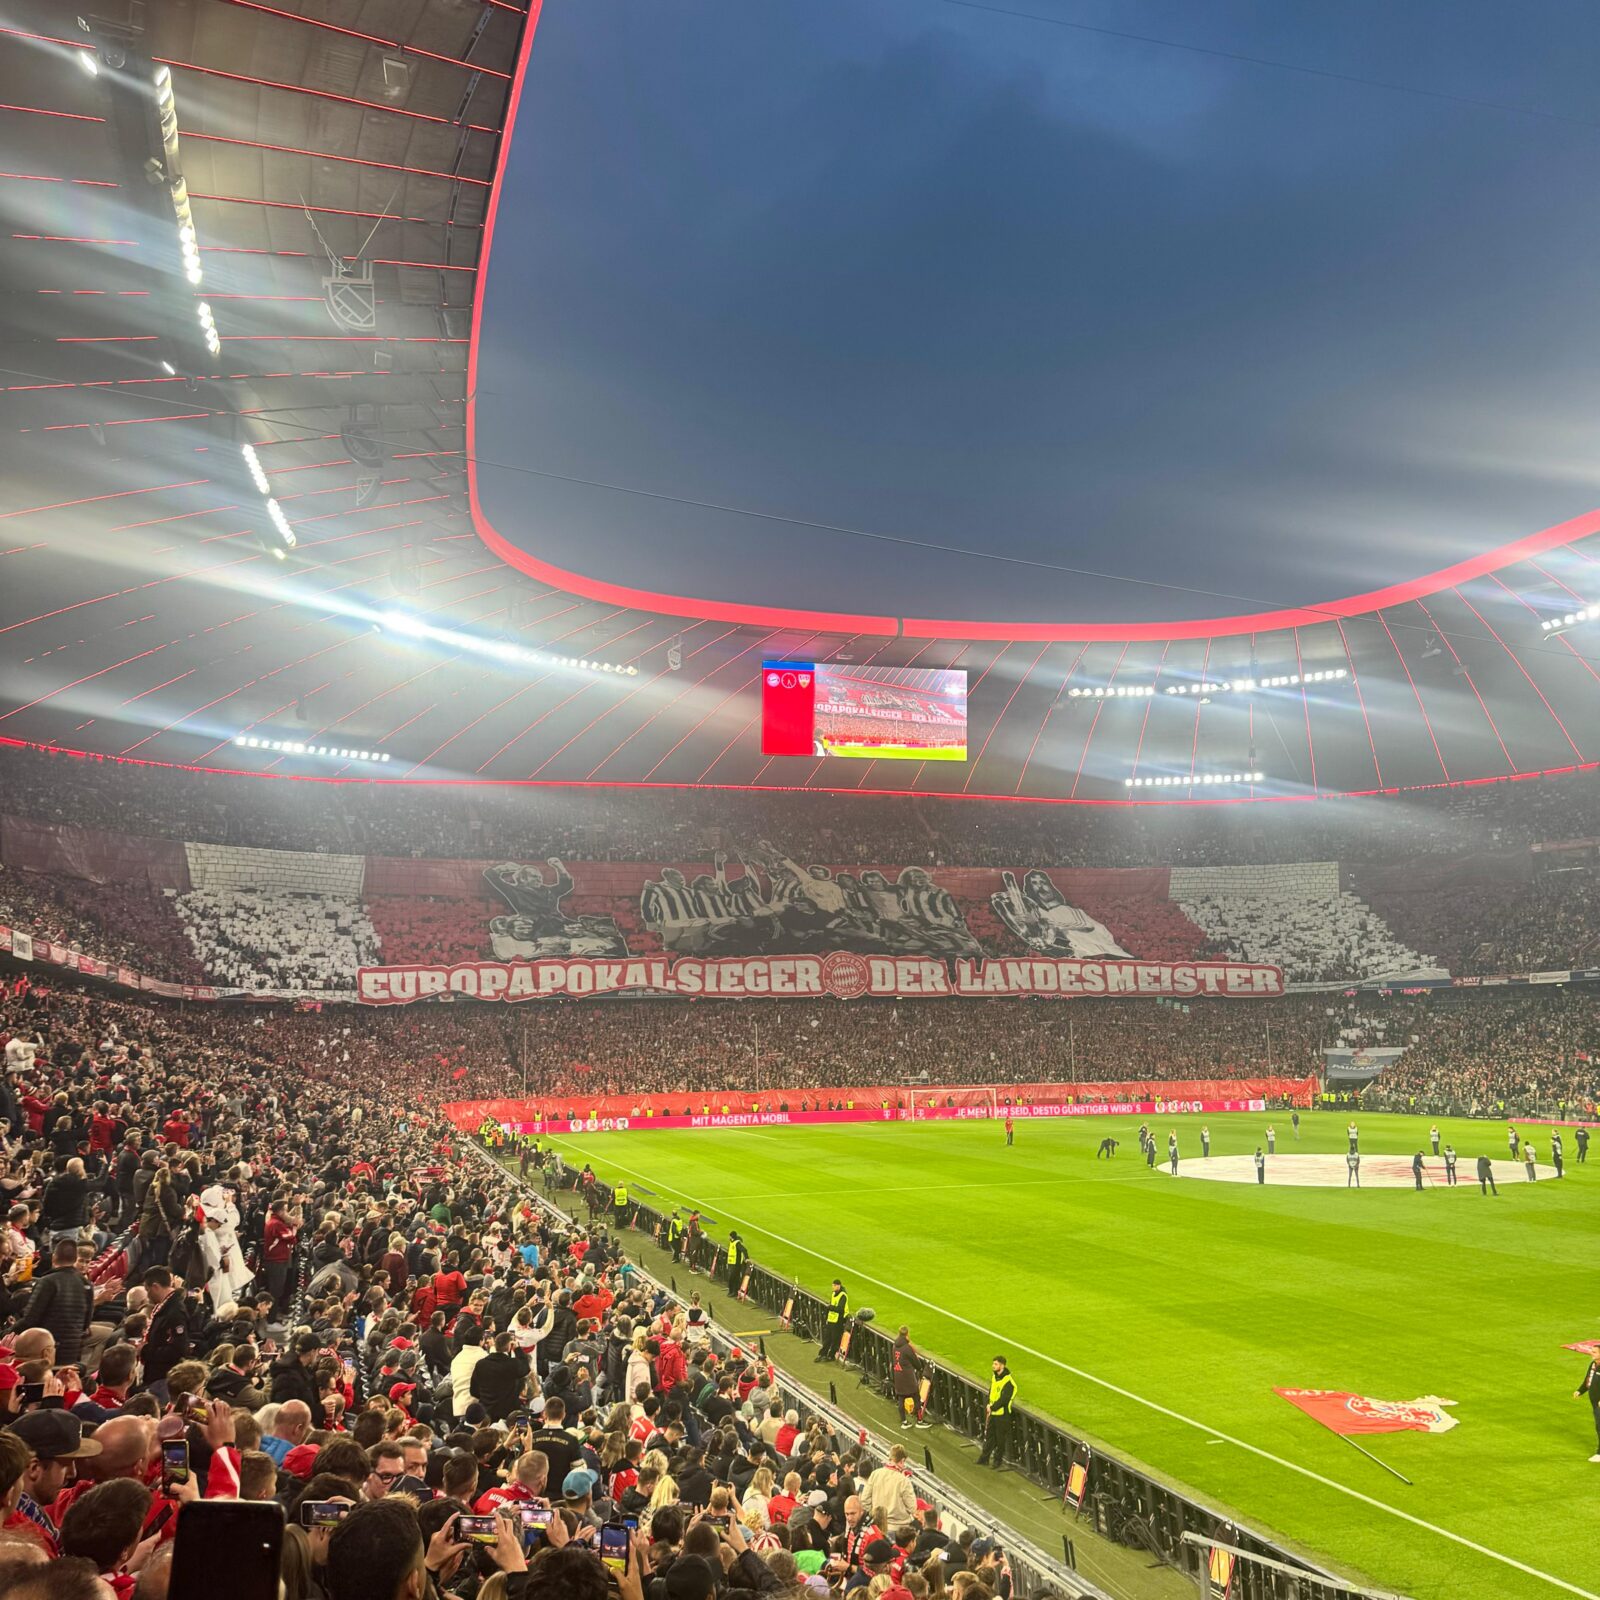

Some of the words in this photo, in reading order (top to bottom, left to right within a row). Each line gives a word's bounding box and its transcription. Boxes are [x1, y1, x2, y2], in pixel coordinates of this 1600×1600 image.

[362, 958, 821, 997] EUROPAPOKALSIEGER
[871, 959, 949, 993] DER
[957, 959, 1281, 994] LANDESMEISTER
[1010, 1106, 1032, 1117] SEID,
[1032, 1106, 1061, 1116] DESTO
[1061, 1104, 1109, 1115] GÜNSTIGER
[691, 1116, 710, 1126] MIT
[711, 1115, 759, 1125] MAGENTA
[760, 1113, 791, 1123] MOBIL
